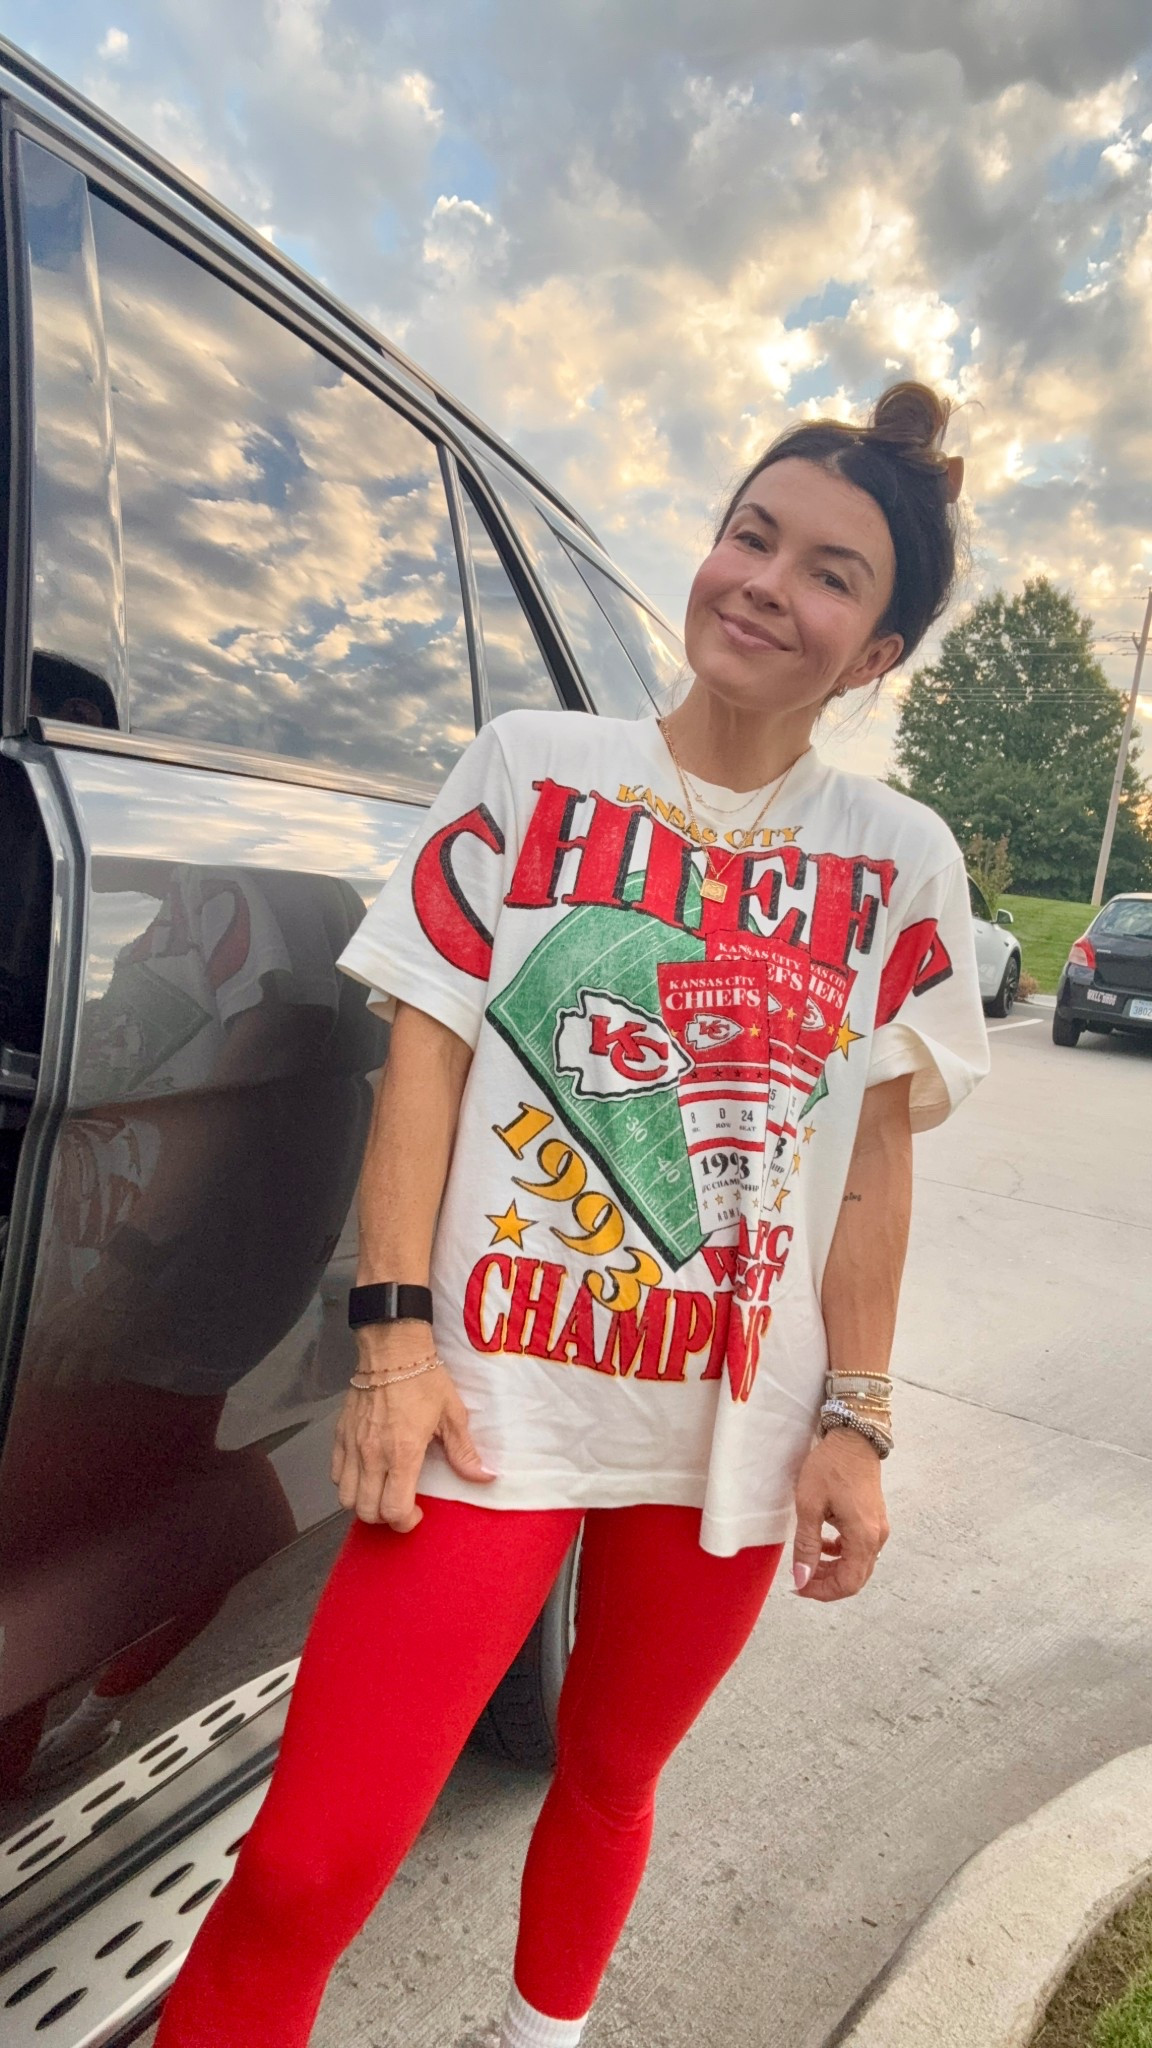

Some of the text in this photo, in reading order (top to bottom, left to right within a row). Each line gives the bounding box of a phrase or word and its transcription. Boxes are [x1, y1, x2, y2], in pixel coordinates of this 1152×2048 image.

[616, 783, 804, 849] KANSAS CITY
[719, 942, 801, 970] KANSAS CITY
[669, 976, 755, 990] KANSAS CITY
[808, 974, 845, 1009] IEFS
[810, 964, 847, 991] SAS CITY
[665, 987, 761, 1011] CHIEFS
[699, 1020, 730, 1040] KC
[589, 1014, 669, 1082] KC
[626, 1115, 648, 1142] 30
[691, 1112, 696, 1123] 8
[741, 1110, 754, 1122] 24
[656, 1155, 681, 1184] 40
[700, 1152, 750, 1180] 1993
[491, 1101, 663, 1313] 1993
[463, 1251, 772, 1403] CHAMPINS
